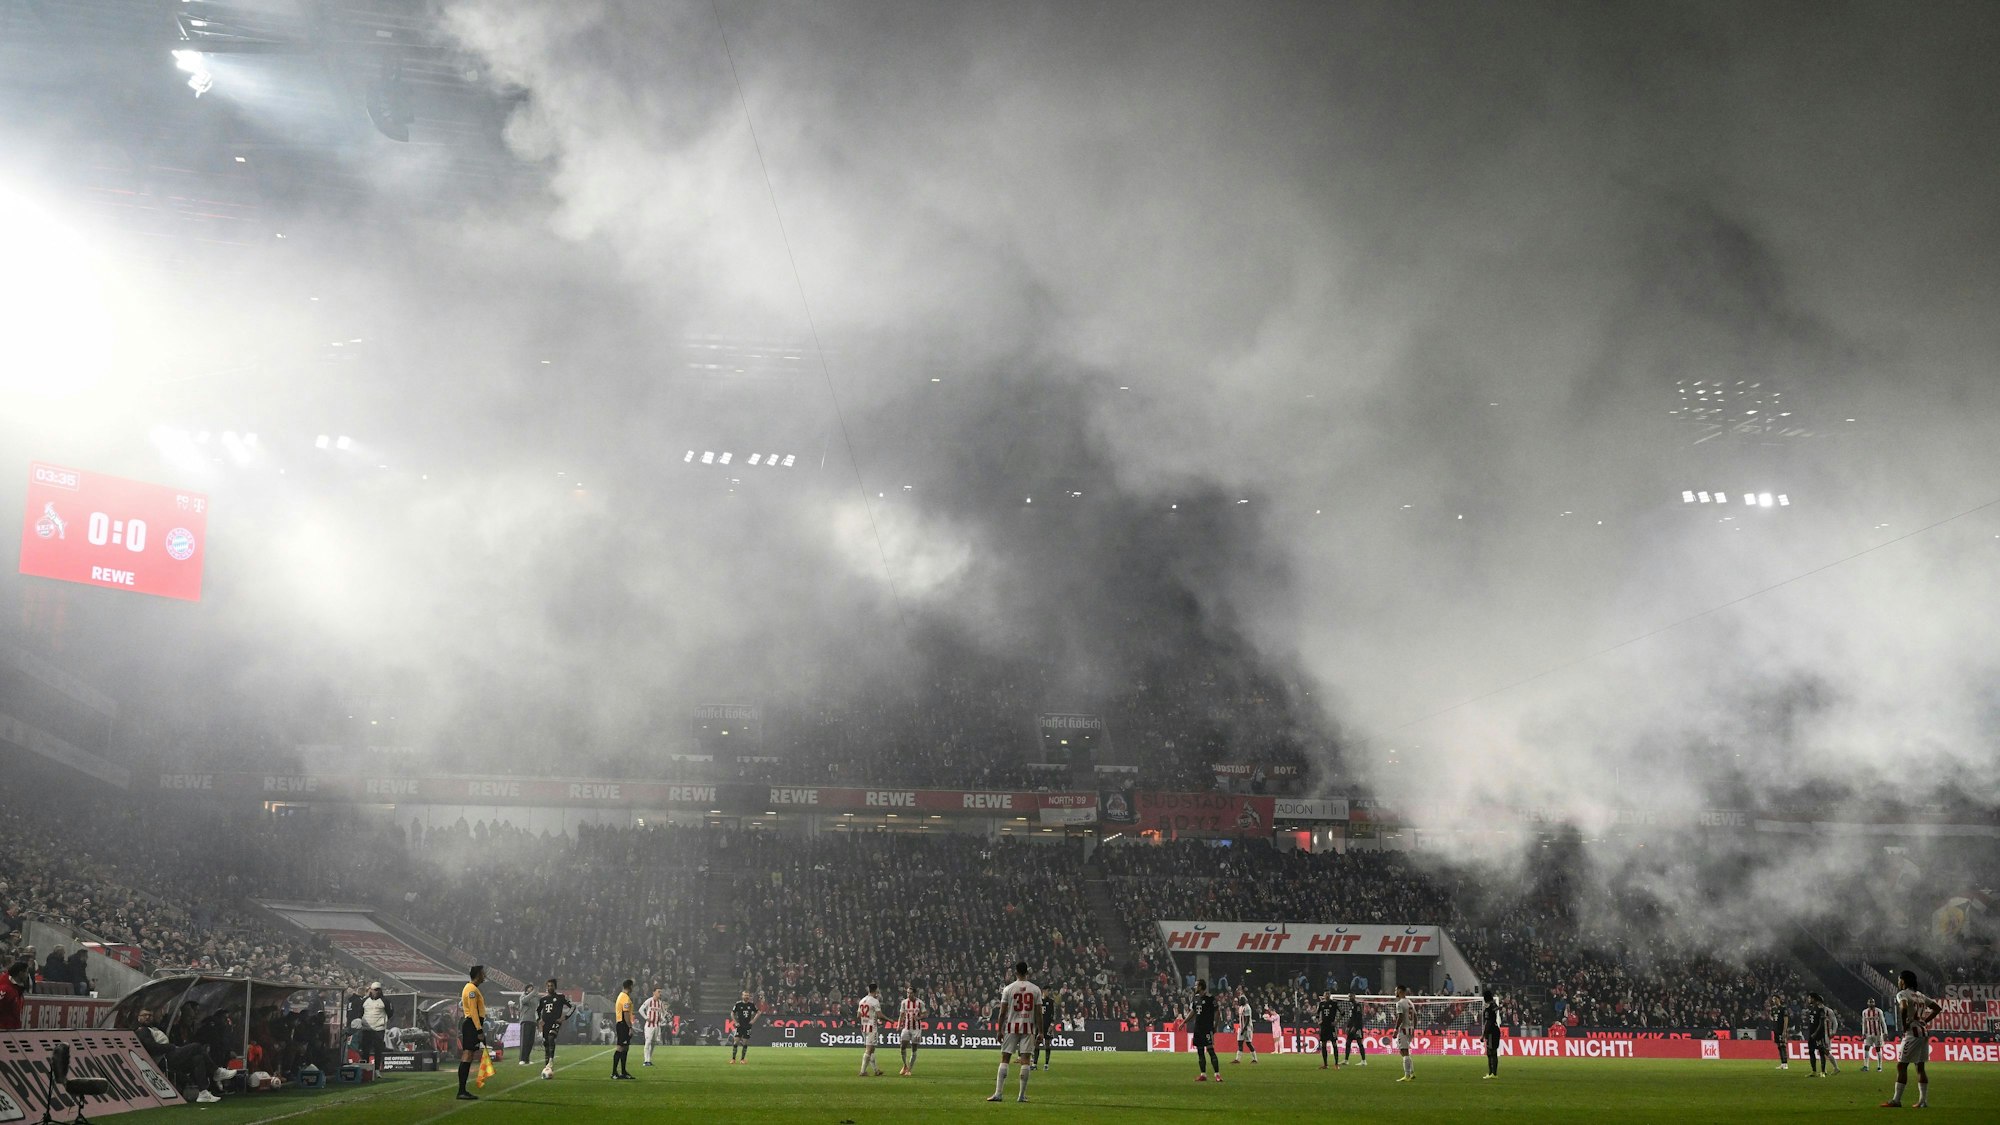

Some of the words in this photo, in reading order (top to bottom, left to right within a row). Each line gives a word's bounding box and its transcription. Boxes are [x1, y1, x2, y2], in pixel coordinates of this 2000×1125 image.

[88, 512, 147, 552] 0:0
[92, 566, 135, 585] REWE
[1273, 765, 1297, 775] BOYZ
[159, 774, 213, 789] REWE
[263, 776, 317, 792] REWE
[366, 778, 419, 794] REWE
[468, 781, 520, 797] REWE
[569, 784, 621, 799] REWE
[669, 786, 717, 801] REWE
[770, 788, 818, 804] REWE
[866, 791, 915, 807] REWE
[963, 793, 1012, 809] REWE
[1048, 796, 1074, 804] NORTH
[1159, 815, 1221, 830] BOYZ
[1700, 812, 1747, 827] REWE
[1167, 931, 1220, 949] HIT
[1236, 932, 1291, 950] HIT
[1307, 934, 1361, 951] HIT
[1377, 935, 1431, 952] HIT
[1013, 992, 1034, 1012] 39
[38, 1005, 62, 1029] REWE
[67, 1006, 89, 1029] REWE
[859, 1004, 870, 1018] 32
[820, 1032, 884, 1046] Speziat
[887, 1033, 901, 1044] fü
[912, 1033, 946, 1045] ushi
[949, 1034, 958, 1045] &
[1443, 1037, 1514, 1056] HABN
[1519, 1039, 1559, 1056] WIR
[1565, 1039, 1634, 1057] NICHT!
[1703, 1043, 1717, 1057] kik
[1945, 1044, 2000, 1062] HABE
